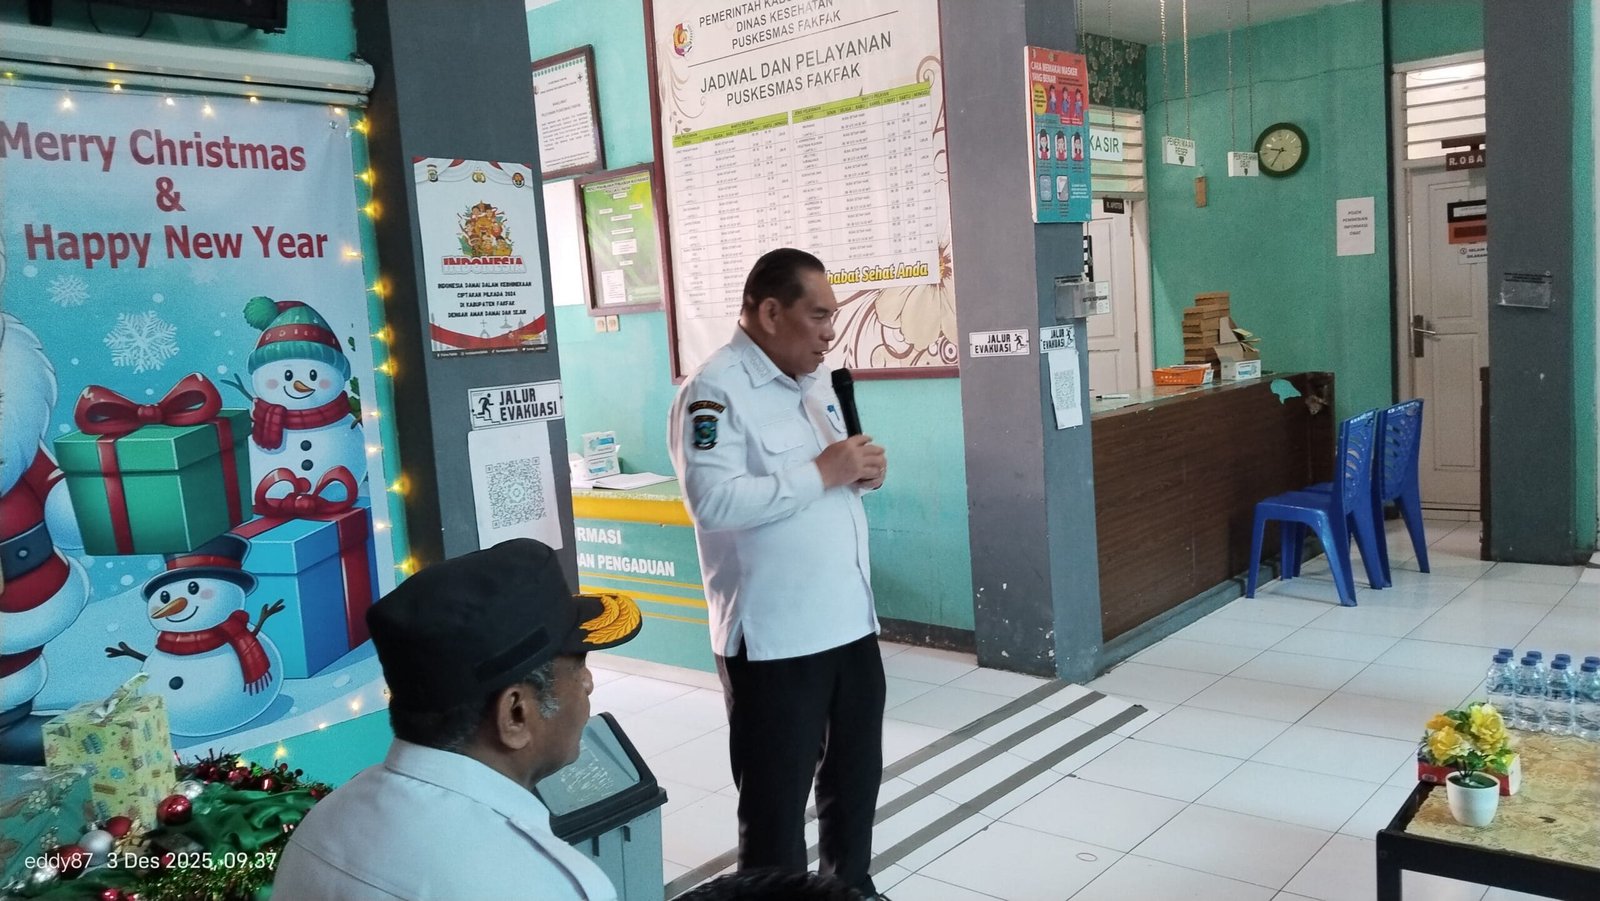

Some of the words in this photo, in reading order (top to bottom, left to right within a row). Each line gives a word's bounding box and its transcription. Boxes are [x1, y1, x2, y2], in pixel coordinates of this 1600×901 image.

[699, 1, 761, 28] PEMERINTAH
[736, 14, 767, 32] DINAS
[769, 0, 833, 23] KESEHATAN
[731, 23, 795, 49] PUSKESMAS
[797, 9, 841, 32] FAKFAK
[700, 64, 758, 94] JADWAL
[760, 56, 792, 79] DAN
[796, 31, 892, 70] PELAYANAN
[726, 77, 803, 106] PUSKESMAS
[806, 62, 861, 88] FAKFAK
[0, 121, 117, 172] Merry
[129, 128, 307, 172] Christmas
[1089, 134, 1120, 153] KASIR
[1448, 154, 1484, 166] R.OBA
[155, 176, 186, 212] &
[24, 223, 152, 268] Happy
[164, 225, 243, 259] New
[252, 226, 328, 259] Year
[442, 255, 525, 271] INDONESIA
[826, 267, 861, 285] habat
[862, 264, 895, 283] Sehat
[896, 261, 929, 279] Anda
[987, 333, 1011, 344] JALUR
[1042, 338, 1066, 350] EVAKUASI
[1050, 328, 1065, 339] JALUR
[974, 343, 1012, 354] EVAKUASI
[499, 387, 536, 406] JALUR
[500, 401, 558, 422] EVAKUASI
[577, 526, 622, 545] RMASI
[577, 552, 595, 569] AN
[597, 554, 675, 577] PENGADUAN
